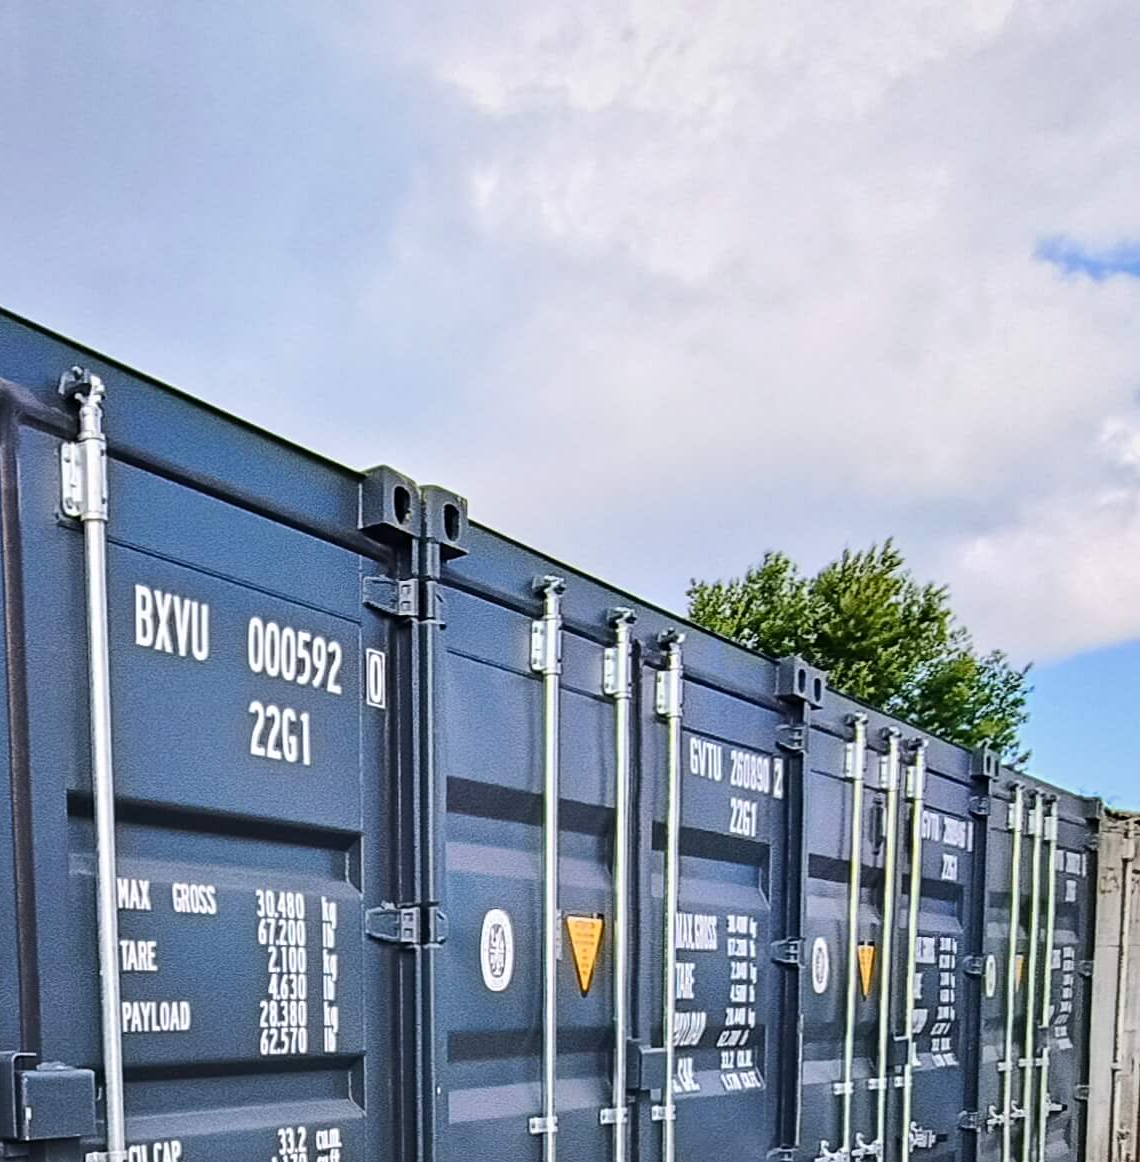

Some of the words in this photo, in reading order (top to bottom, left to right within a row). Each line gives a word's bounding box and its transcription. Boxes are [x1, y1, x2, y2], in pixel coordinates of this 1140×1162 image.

[135, 584, 209, 661] BXVU
[248, 617, 342, 695] 000592
[249, 701, 311, 766] 22G1
[690, 737, 722, 781] GVTU
[729, 798, 757, 837] 22G1
[116, 878, 151, 911] MAX
[171, 882, 217, 915] GROSS
[255, 889, 305, 919] 30.480
[321, 896, 337, 930] kg
[258, 918, 306, 946] 67.200
[119, 940, 158, 972] TARE
[268, 946, 307, 973] 2.100
[322, 949, 338, 981] kg
[268, 974, 308, 1000] 4.630
[122, 1001, 191, 1033] PAYLOAD
[260, 1000, 308, 1028] 28.380
[323, 1002, 339, 1033] kg
[260, 1027, 308, 1056] 62.570
[278, 1126, 307, 1155] 33.2
